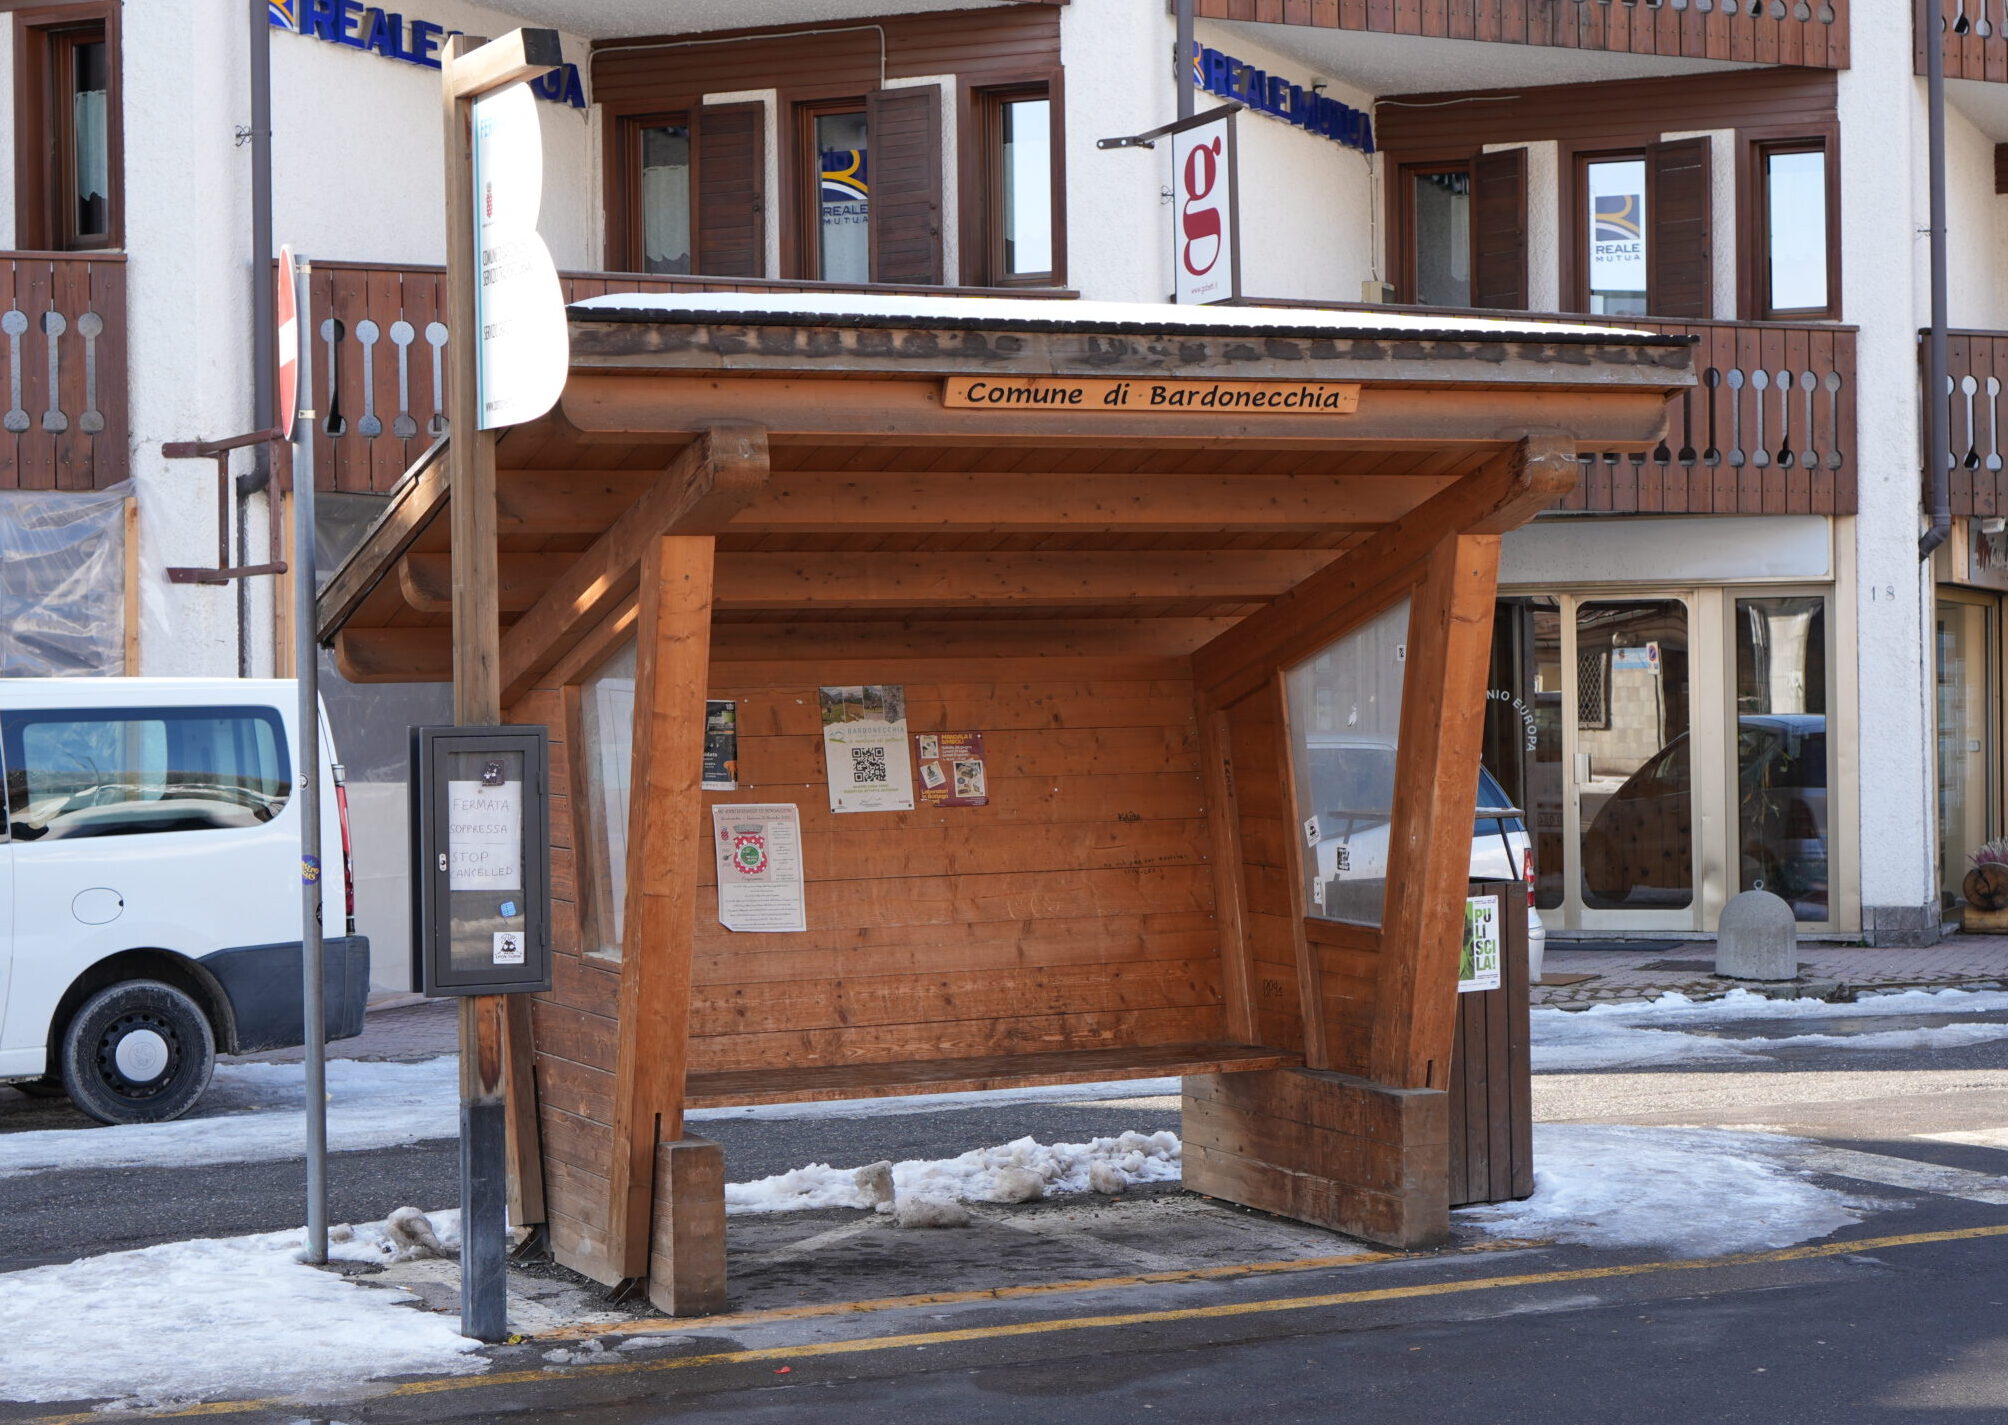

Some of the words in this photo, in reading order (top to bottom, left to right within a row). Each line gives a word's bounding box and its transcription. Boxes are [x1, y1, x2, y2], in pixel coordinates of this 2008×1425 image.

[300, 0, 443, 69] REALE
[822, 203, 869, 217] REALE
[822, 216, 868, 225] MUTUA
[1595, 243, 1640, 255] REALE
[1595, 254, 1640, 262] MUTUA
[966, 382, 1083, 405] Comune
[1103, 383, 1130, 406] di
[1149, 385, 1340, 409] Bardonecchia
[847, 726, 905, 735] BARDONECCHIA
[1512, 697, 1537, 752] EUROPA
[453, 799, 509, 812] FERMATA
[449, 824, 508, 834] SOPPRESSA
[452, 851, 489, 863] STOP
[450, 866, 514, 880] CANCELLED
[1474, 908, 1492, 923] PU
[1475, 924, 1487, 939] LI
[1475, 939, 1497, 955] SCI
